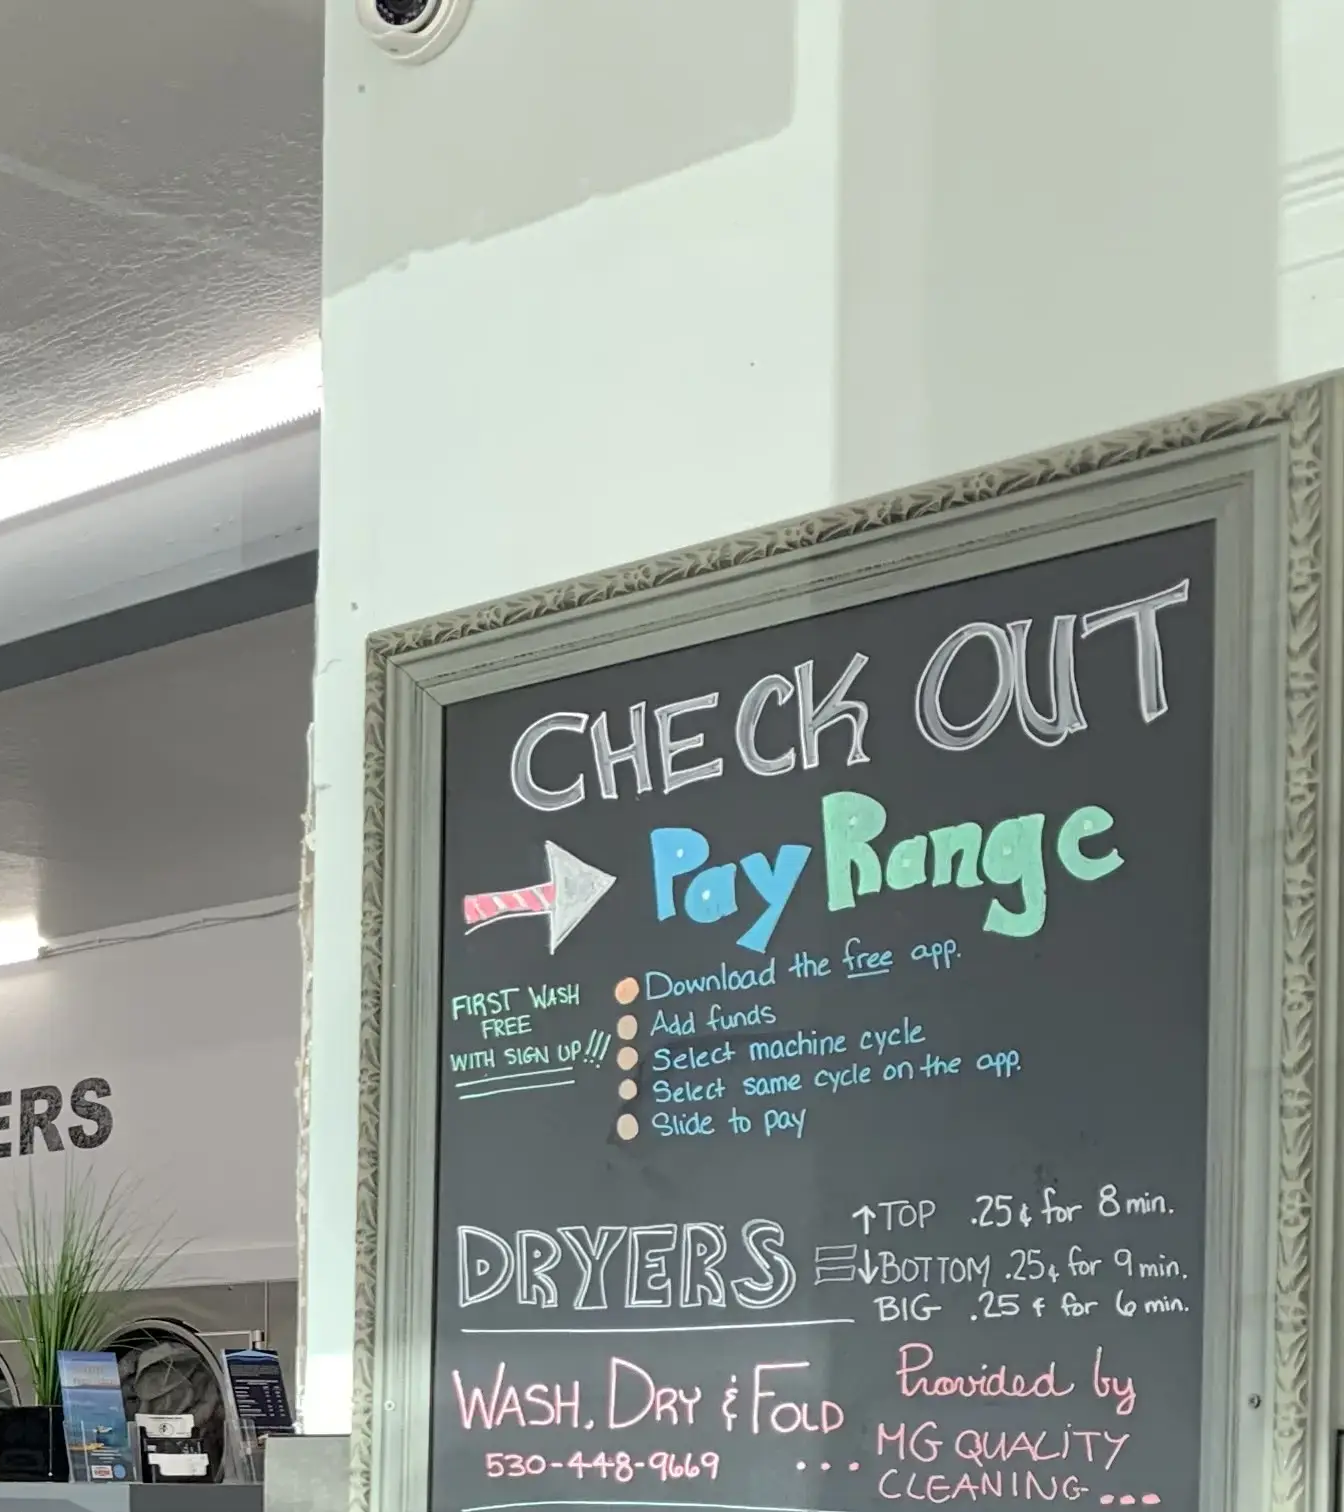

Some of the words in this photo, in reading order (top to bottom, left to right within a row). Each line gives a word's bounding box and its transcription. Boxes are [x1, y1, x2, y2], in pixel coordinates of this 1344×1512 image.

[510, 652, 871, 811] CHECK
[914, 578, 1190, 751] OUT
[645, 957, 775, 1001] Download
[788, 951, 831, 978] the
[842, 937, 893, 970] free
[911, 938, 962, 970] app.
[451, 987, 520, 1021] FIRST
[528, 983, 580, 1010] WASH
[650, 1009, 695, 1037] Add
[706, 1003, 777, 1032] funds
[481, 1014, 533, 1040] FREE
[652, 1041, 736, 1071] Select
[749, 1030, 847, 1062] machine
[860, 1016, 926, 1056] cycle
[450, 1048, 495, 1072] WITH
[503, 1045, 549, 1066] SIGN
[557, 1028, 612, 1069] UP!!!
[652, 1078, 726, 1103] Select
[743, 1072, 802, 1097] same
[814, 1063, 871, 1094] cycle
[883, 1060, 913, 1082] on
[920, 1053, 962, 1079] the
[976, 1049, 1022, 1079] app.
[651, 1111, 716, 1137] Slide
[728, 1107, 752, 1134] to
[764, 1108, 806, 1138] pay
[878, 1198, 937, 1231] TOP
[1041, 1187, 1083, 1225] for
[1098, 1184, 1121, 1218] 8
[1127, 1192, 1175, 1216] min.
[457, 1218, 797, 1309] DRYERS
[878, 1251, 990, 1287] BOTTOM
[1068, 1245, 1102, 1277] for
[1114, 1248, 1133, 1277] 9
[1139, 1255, 1188, 1280] min.
[873, 1293, 942, 1322] BIG
[1061, 1292, 1099, 1317] for
[1115, 1289, 1137, 1318] 6
[1144, 1298, 1189, 1314] min.
[895, 1342, 1075, 1398] Provided
[1092, 1345, 1137, 1416] by
[721, 1374, 739, 1431] &
[876, 1421, 944, 1462] MG
[485, 1451, 721, 1482] 530-448-9669
